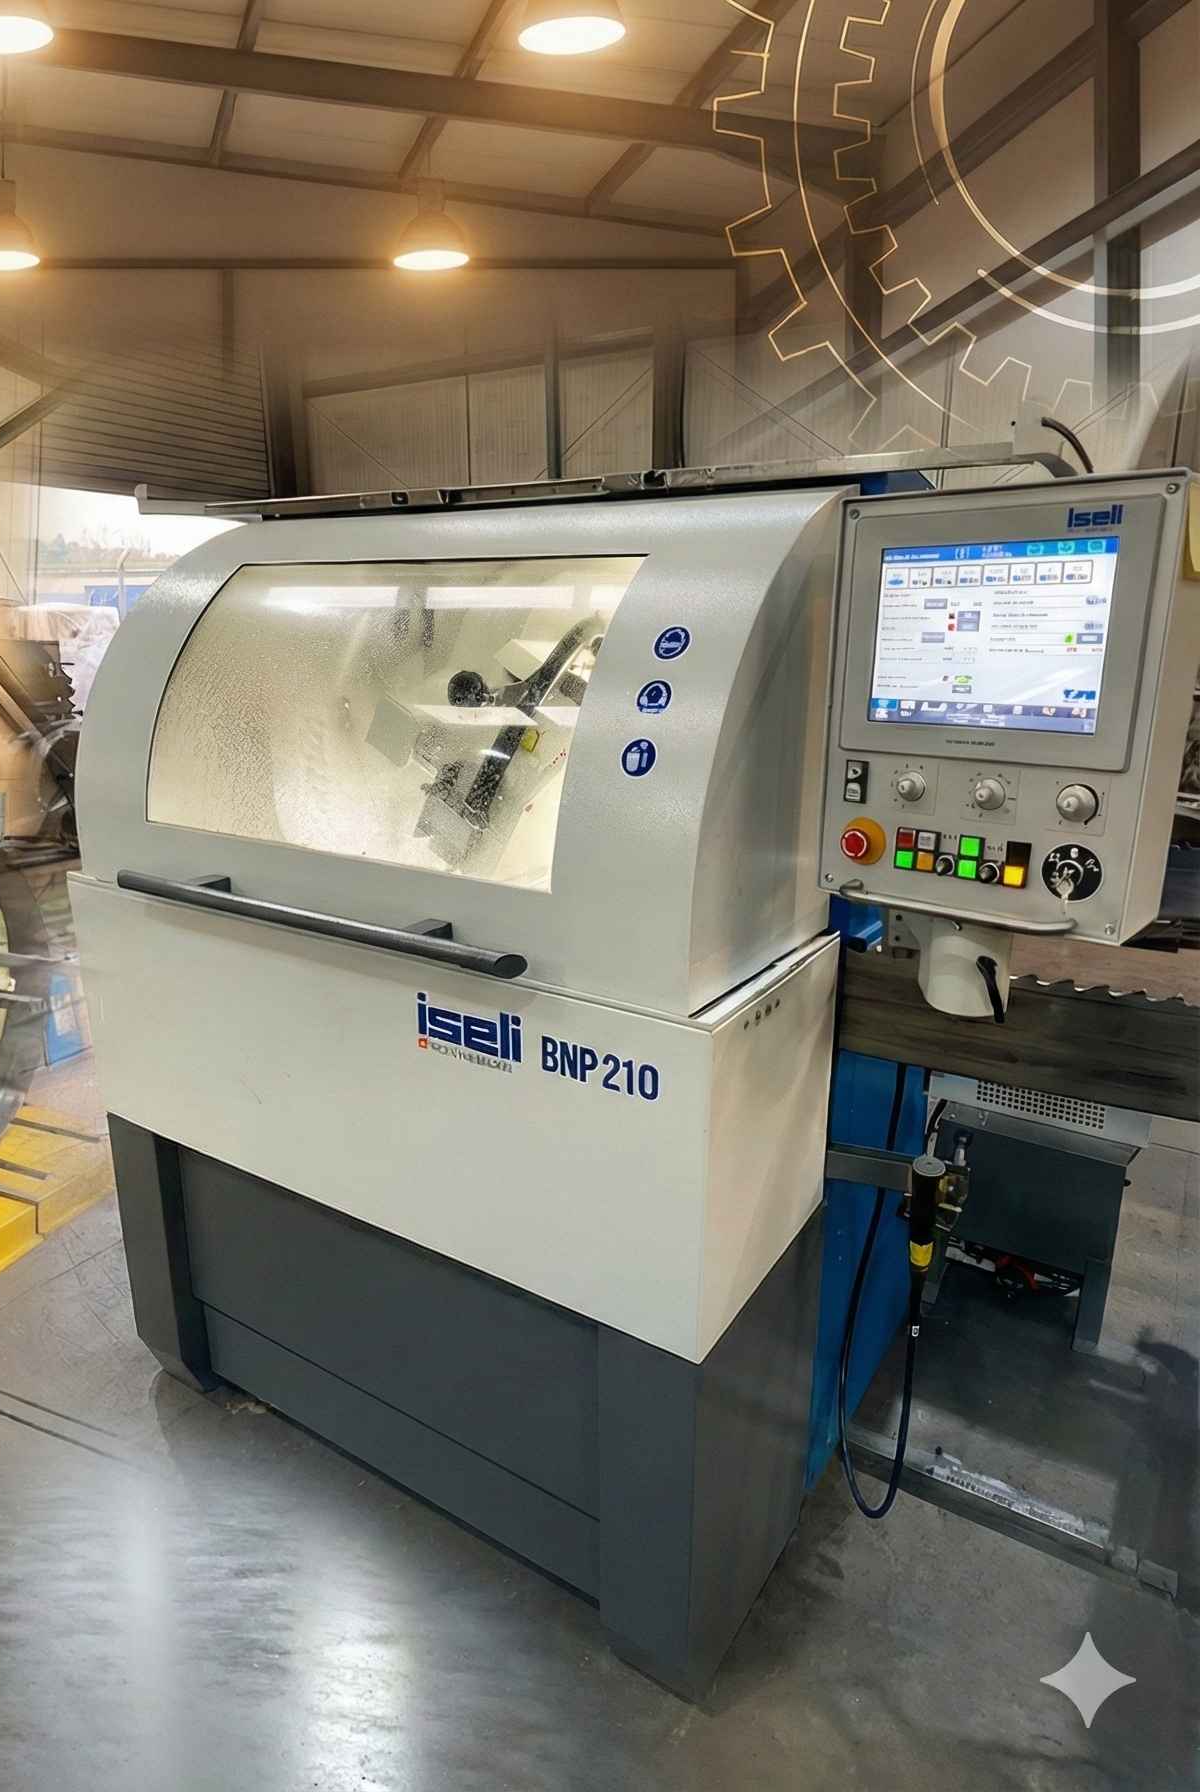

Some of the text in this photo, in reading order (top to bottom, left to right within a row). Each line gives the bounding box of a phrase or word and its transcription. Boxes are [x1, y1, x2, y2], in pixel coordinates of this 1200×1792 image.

[417, 992, 522, 1063] iseli
[541, 1035, 599, 1083] BNP
[602, 1053, 660, 1101] 210
